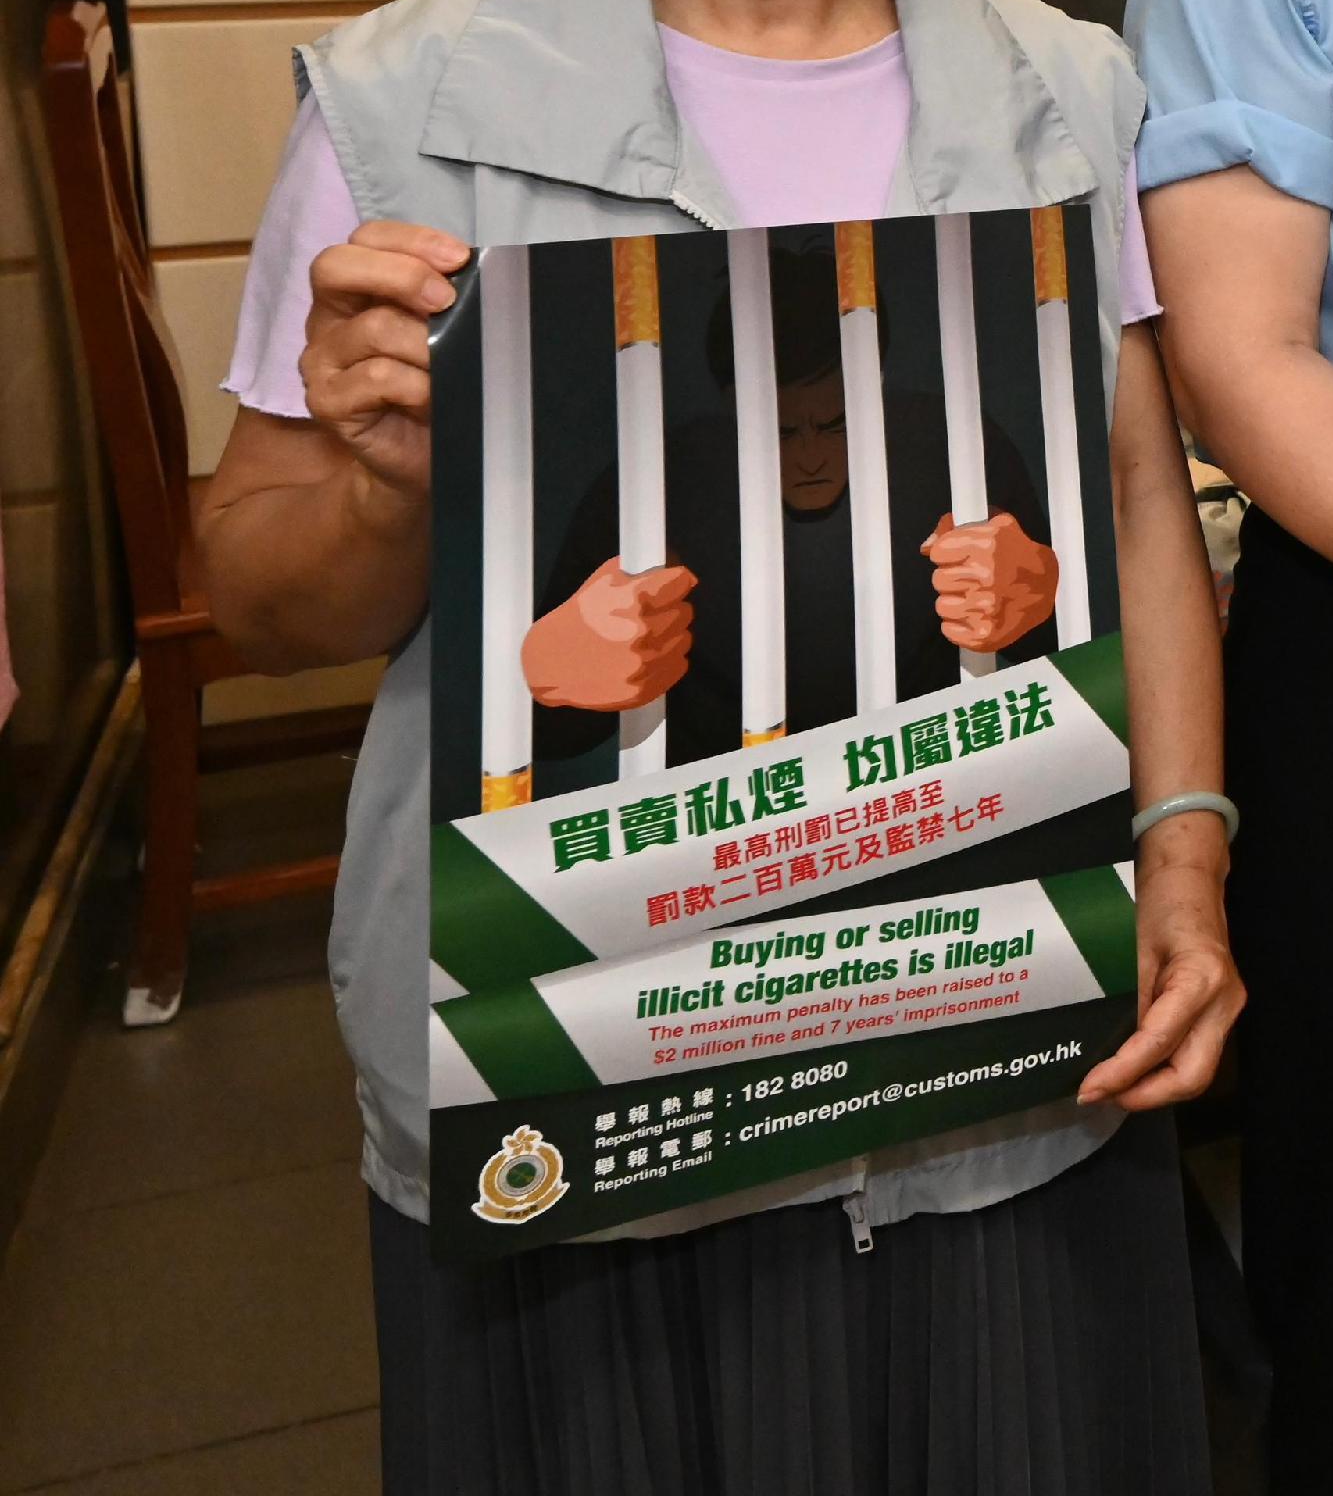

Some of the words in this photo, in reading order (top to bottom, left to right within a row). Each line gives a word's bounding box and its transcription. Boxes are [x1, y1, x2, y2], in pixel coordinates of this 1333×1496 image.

[549, 757, 807, 873] 買賣私煙
[843, 682, 1055, 793] 均屬違法
[646, 793, 1004, 927] 罰款二百萬元及監禁七年
[713, 779, 945, 871] 最高刑罰已提高至
[636, 980, 726, 1018] illicit
[734, 955, 899, 1006] cigarettes
[908, 948, 936, 977] is
[944, 928, 1034, 970] illegal
[710, 930, 826, 969] Buying
[835, 923, 871, 951] or
[878, 906, 981, 942] selling
[648, 1023, 683, 1042] The
[689, 1010, 782, 1035] maximum
[787, 996, 854, 1023] penalty
[858, 990, 890, 1008] has
[895, 982, 938, 1002] been
[942, 972, 994, 994] raised
[998, 970, 1015, 985] to
[1019, 969, 1029, 981] a
[653, 1048, 677, 1065] $2
[682, 1036, 746, 1060] million
[751, 1029, 787, 1050] fine
[790, 1022, 825, 1042] and
[830, 1019, 841, 1035] 7
[845, 1009, 900, 1034] years'
[903, 990, 1021, 1023] imprisonment
[594, 1087, 714, 1133] 舉報熱線
[741, 1076, 784, 1103] 182
[790, 1060, 849, 1091] 8080
[594, 1129, 712, 1176] 舉報電郵
[738, 1039, 1083, 1143] crimereport@customs.gov.hk
[595, 1123, 663, 1149] Reporting
[665, 1110, 714, 1132] Hotline
[594, 1165, 667, 1193] Reporting
[671, 1151, 712, 1172] Email
